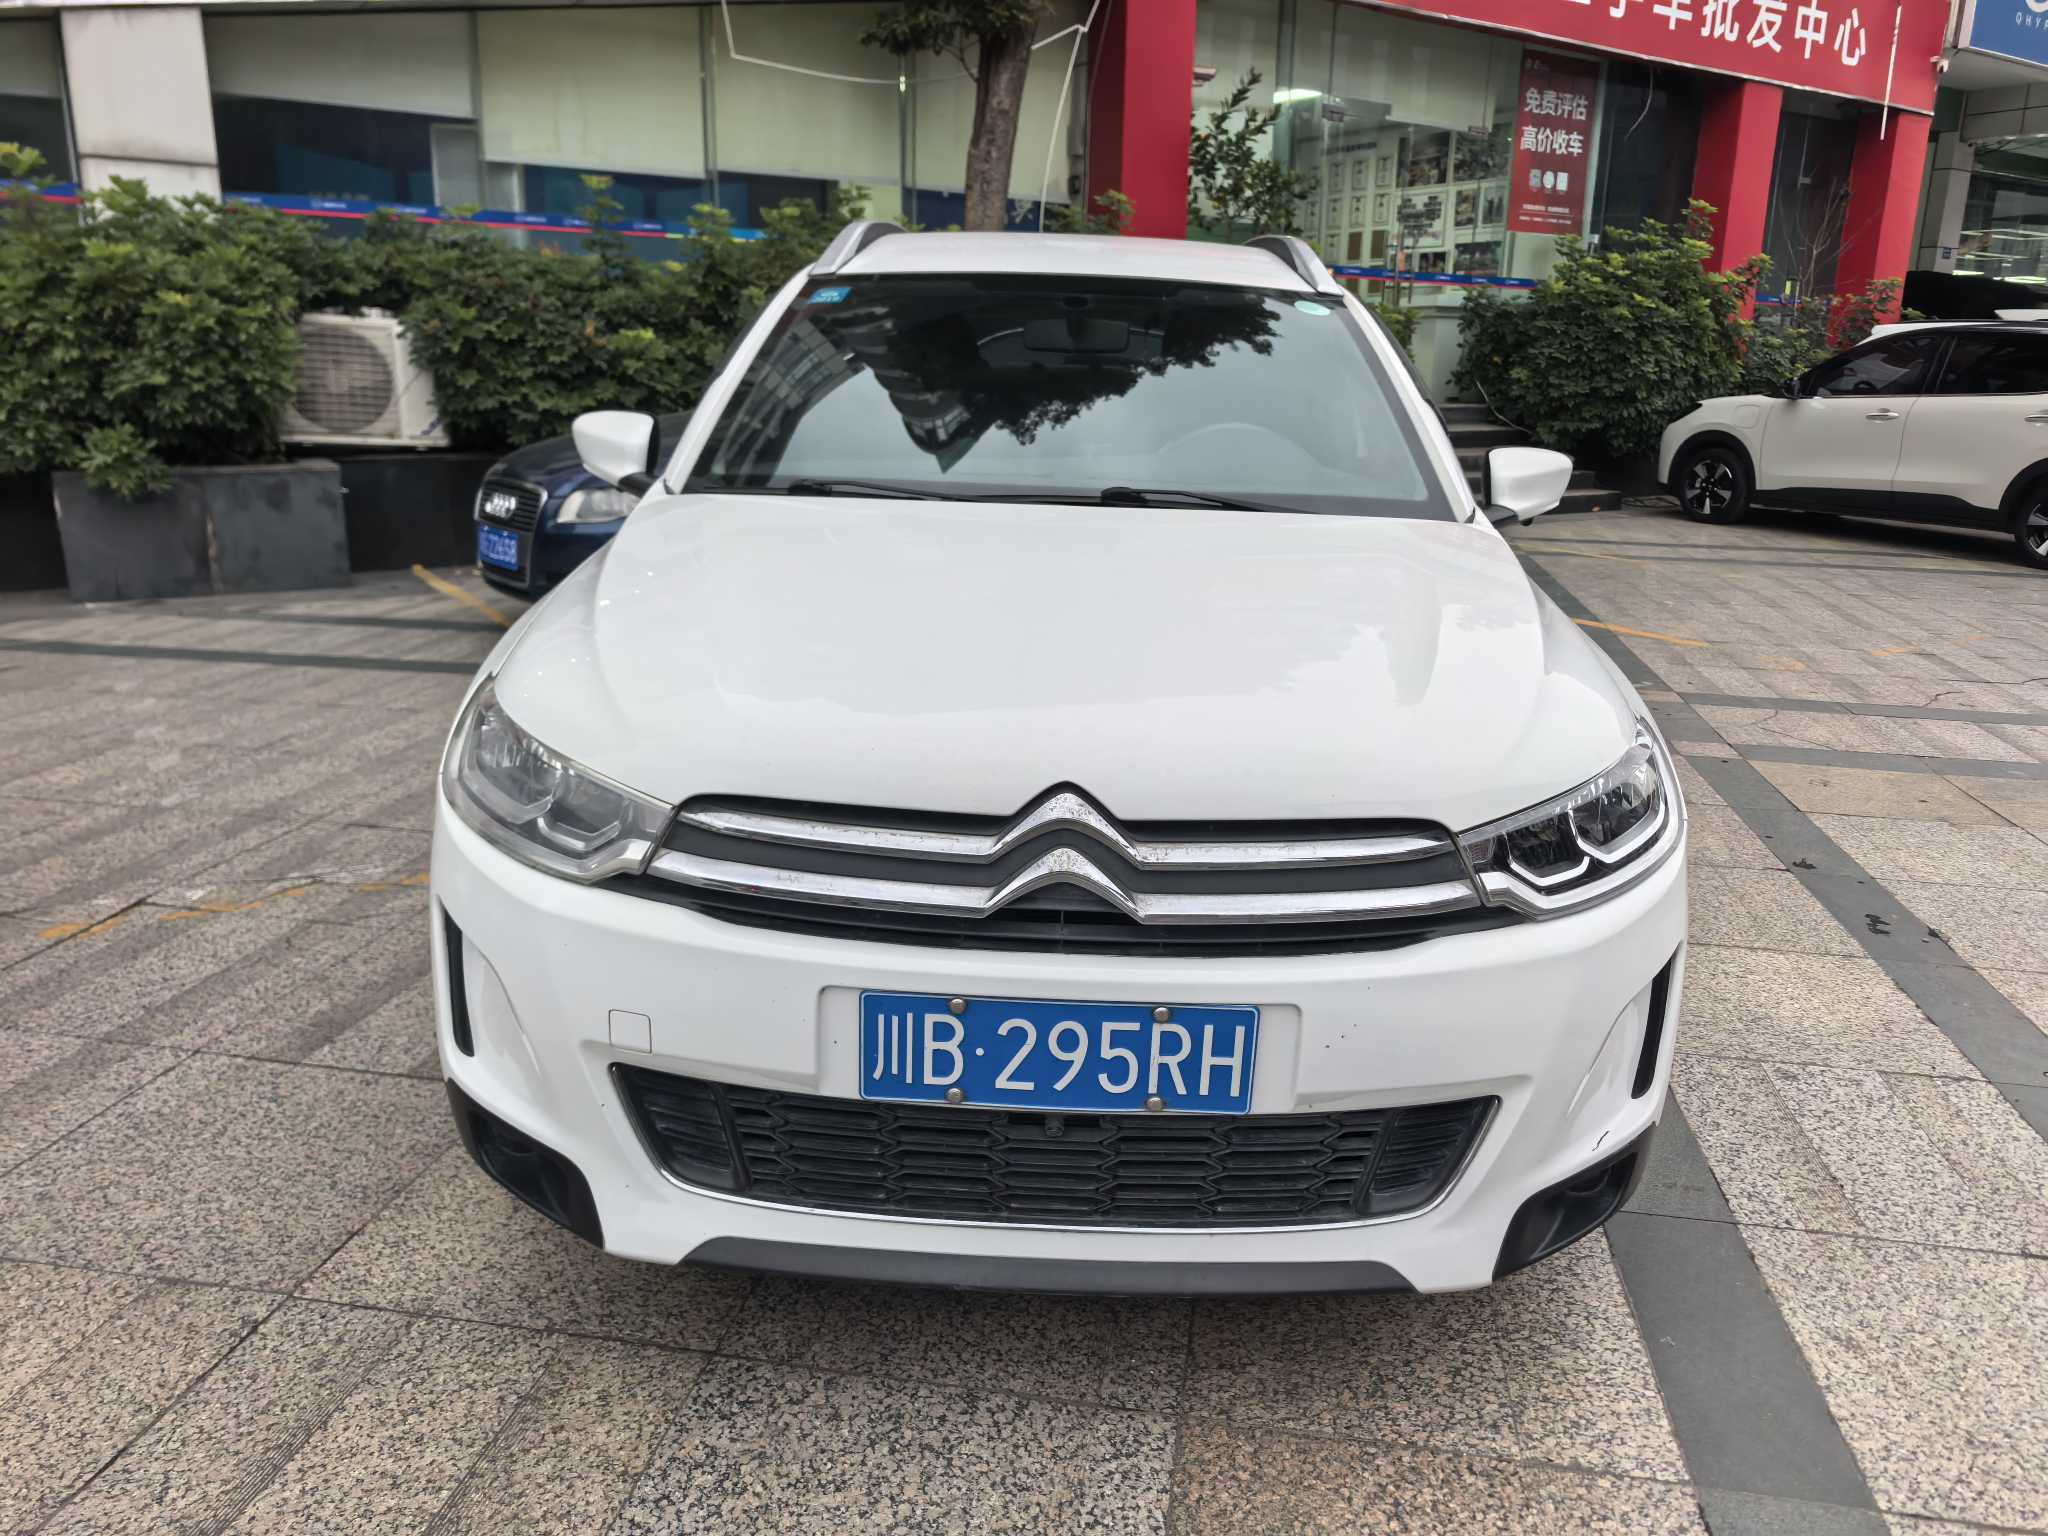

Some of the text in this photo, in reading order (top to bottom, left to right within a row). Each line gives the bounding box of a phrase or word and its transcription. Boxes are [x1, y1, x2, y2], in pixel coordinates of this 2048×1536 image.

[1524, 88, 1588, 120] 免费评估
[1520, 125, 1584, 157] 高价收车
